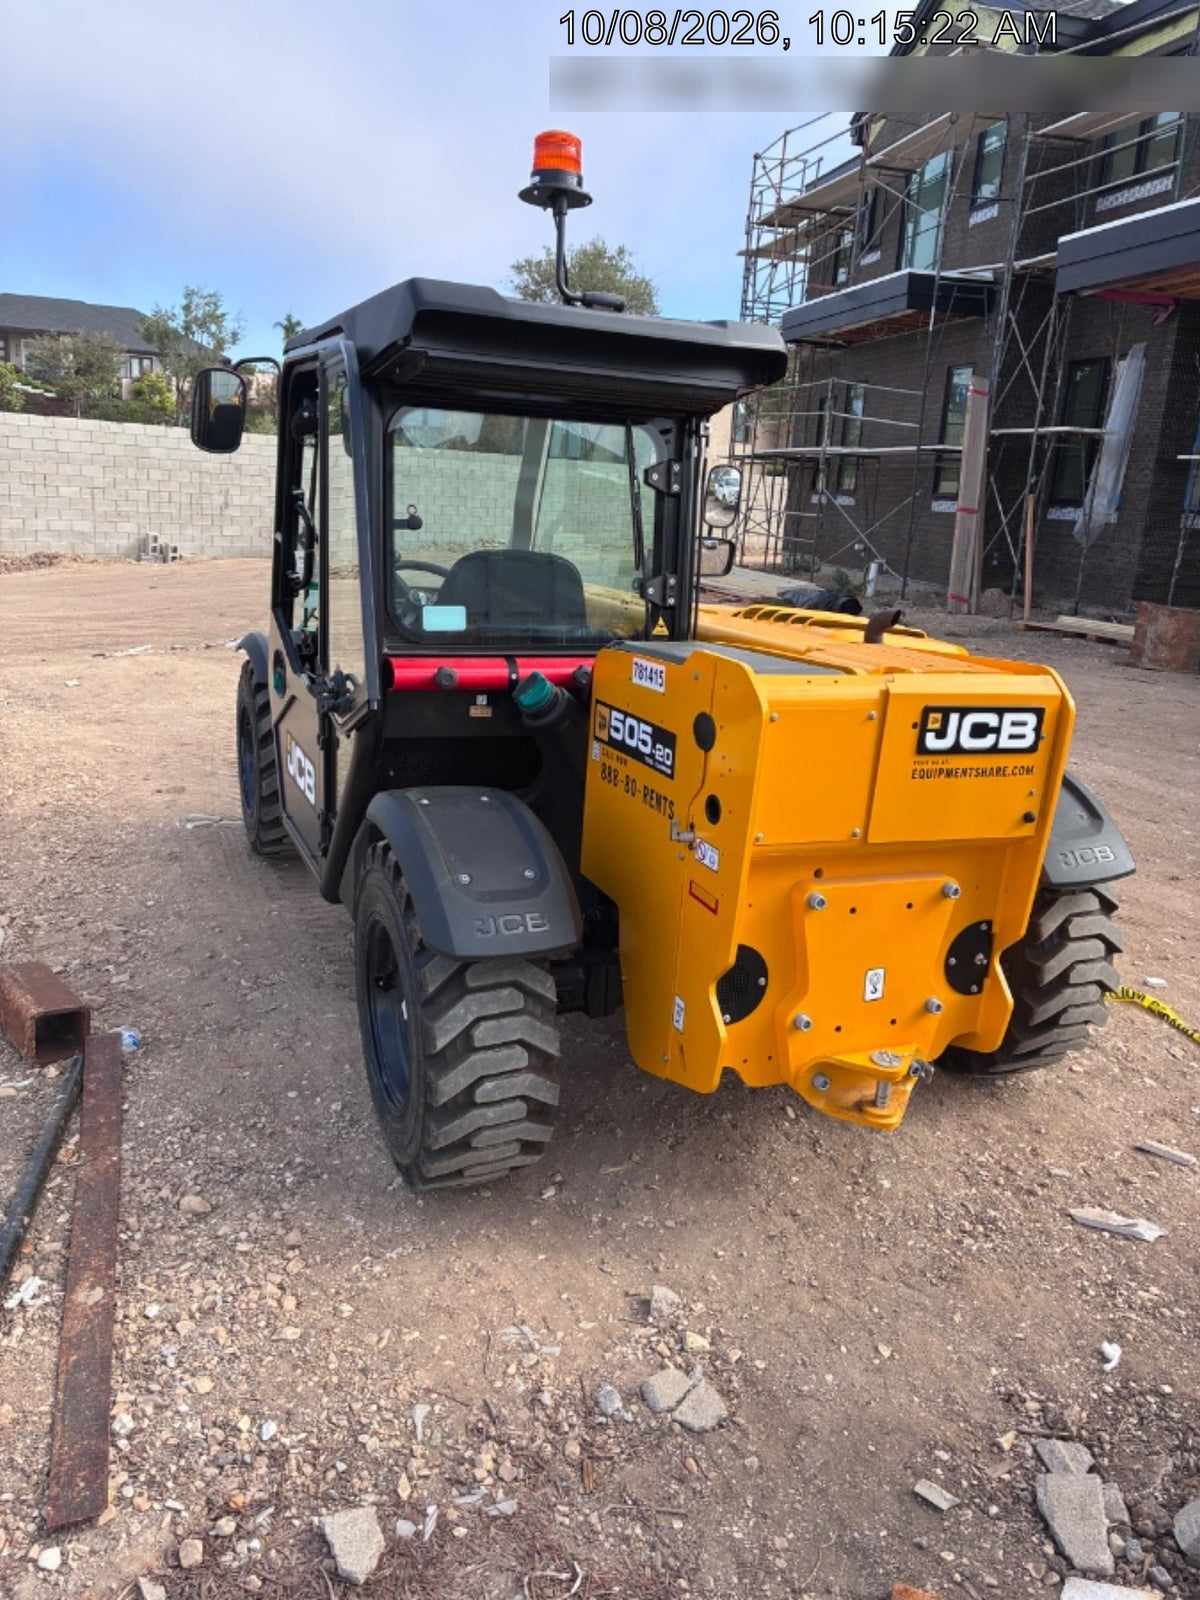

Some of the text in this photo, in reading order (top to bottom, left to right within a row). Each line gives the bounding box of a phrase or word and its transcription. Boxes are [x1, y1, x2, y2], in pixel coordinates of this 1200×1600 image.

[633, 661, 664, 688] 781415
[925, 712, 1038, 751] JCB
[287, 739, 316, 806] JCB
[911, 765, 1035, 780] EQUIPMENTSHARE.COM
[601, 761, 675, 821] 888-80-RENTS
[1058, 845, 1117, 869] JCB
[473, 912, 550, 938] JCB
